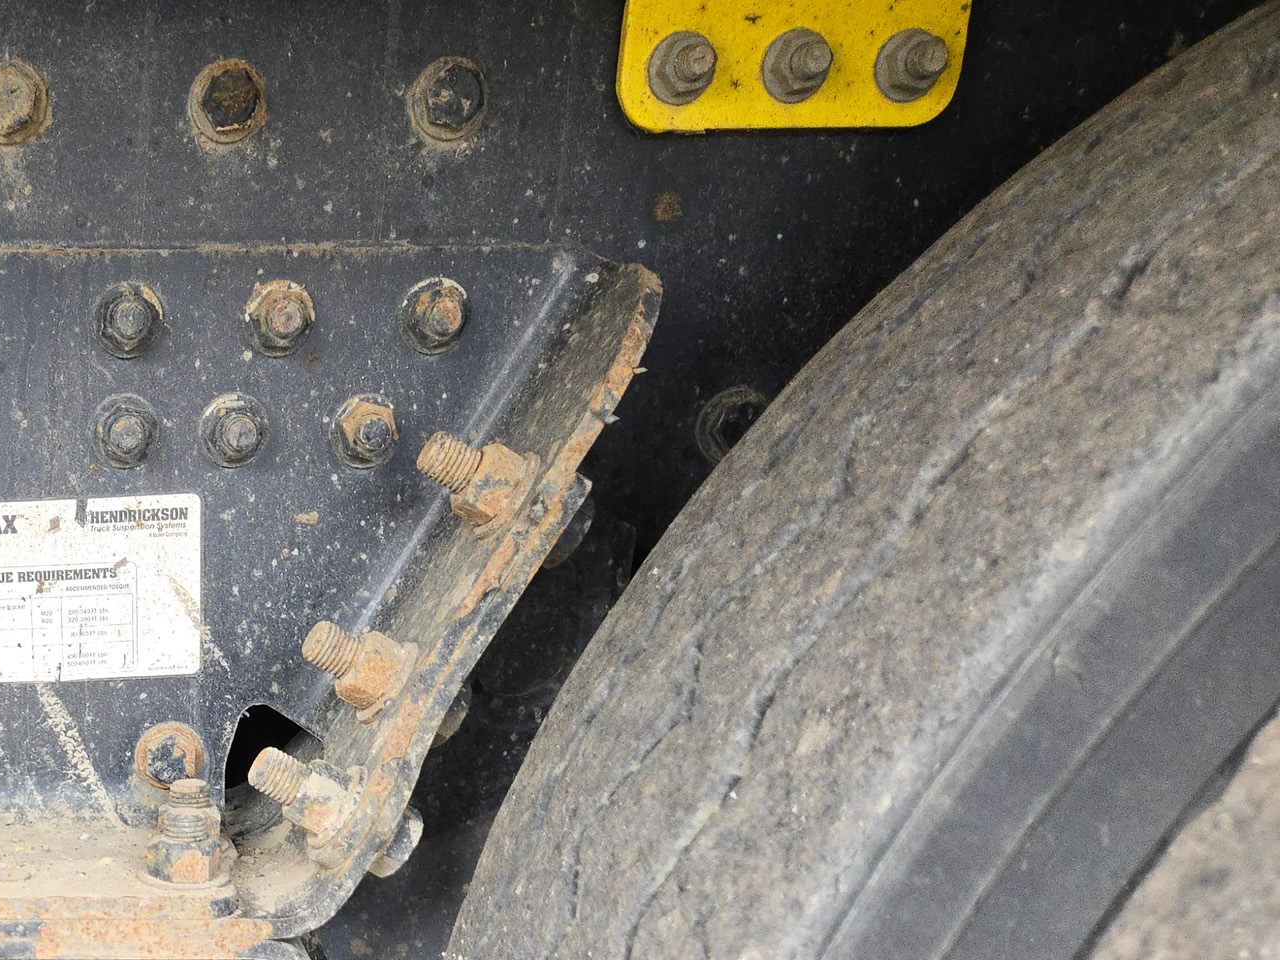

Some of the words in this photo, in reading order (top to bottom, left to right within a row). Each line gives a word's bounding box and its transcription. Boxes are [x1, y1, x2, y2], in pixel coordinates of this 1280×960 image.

[90, 507, 188, 524] HENDRICKSON
[112, 523, 155, 532] Suspension
[156, 522, 186, 531] Systems
[17, 567, 117, 583] REQUIREMENTS
